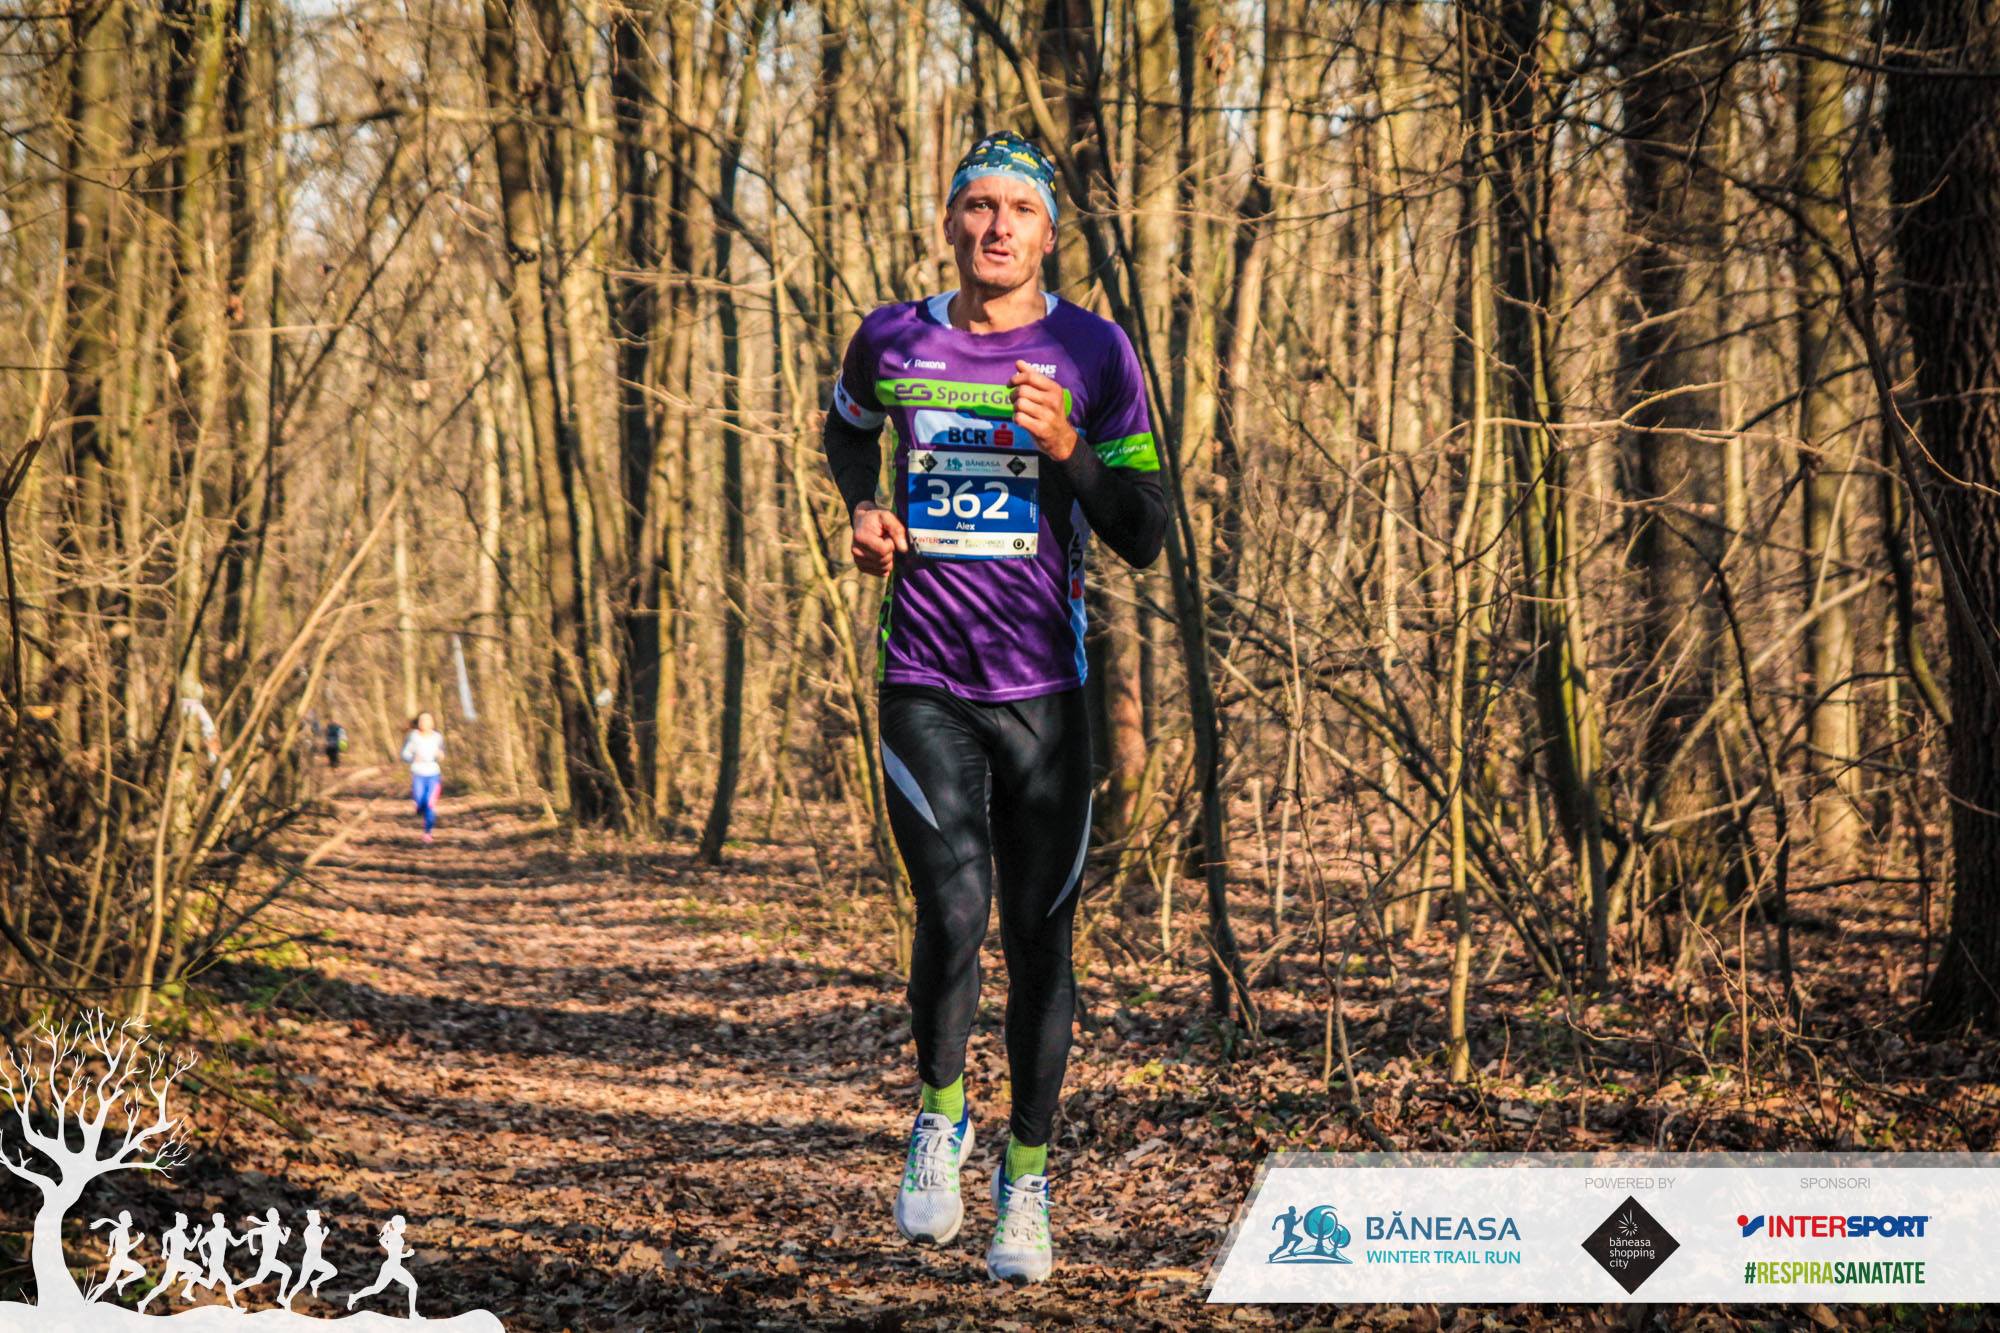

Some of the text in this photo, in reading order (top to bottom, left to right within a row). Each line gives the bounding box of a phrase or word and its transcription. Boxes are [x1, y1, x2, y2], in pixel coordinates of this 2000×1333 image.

[914, 359, 946, 370] Rexona
[948, 426, 987, 445] BCR
[927, 478, 1009, 519] 362
[955, 521, 975, 531] Alex
